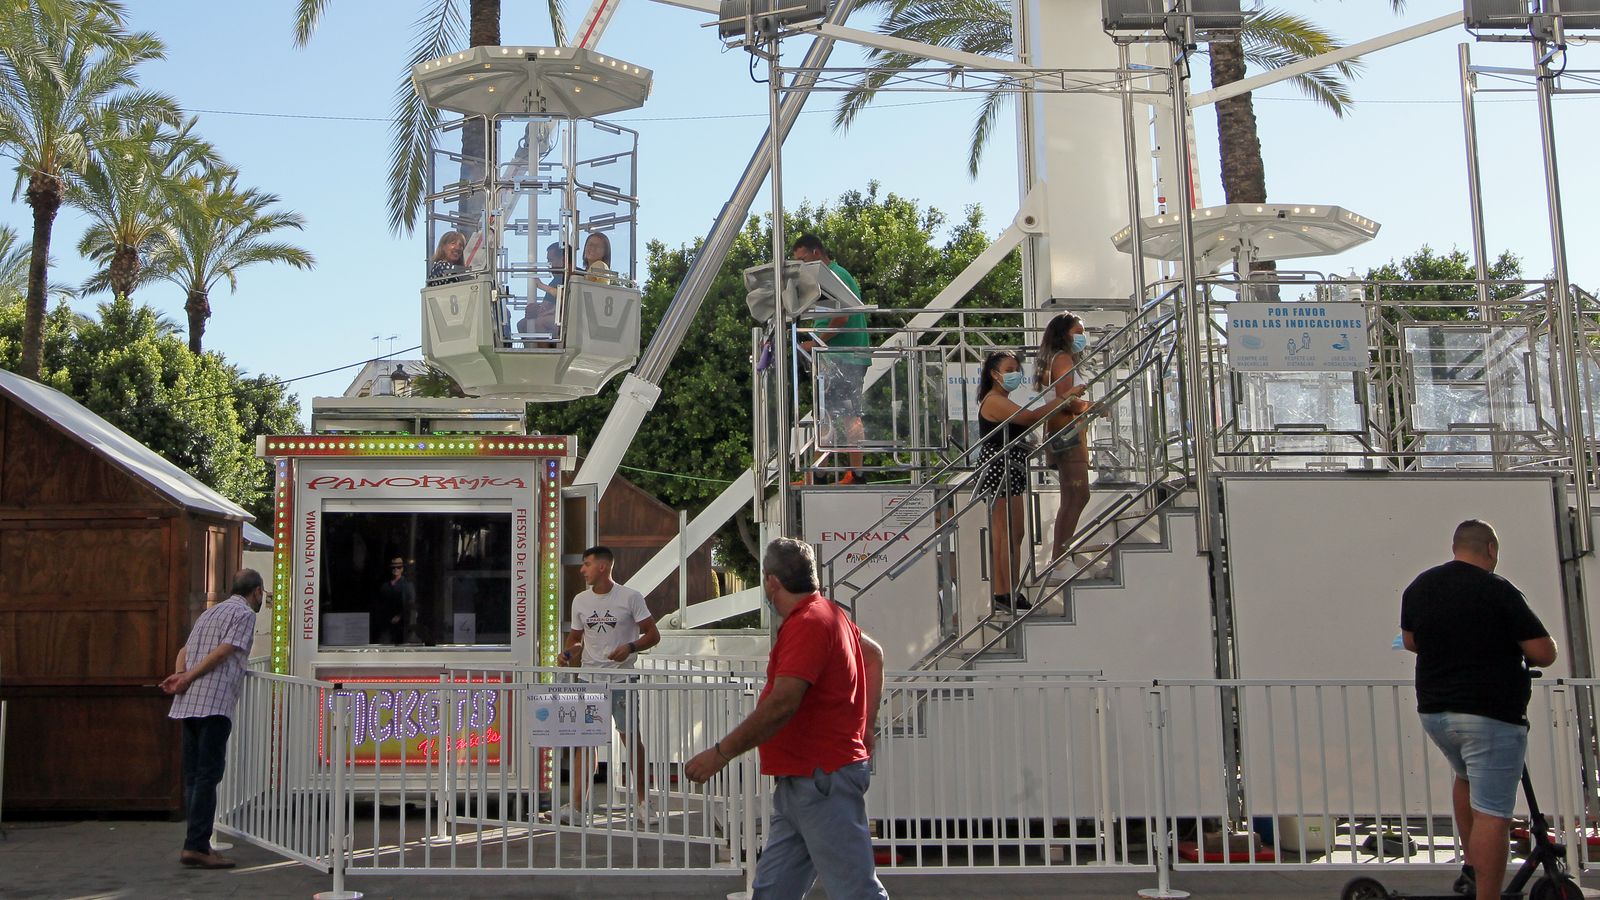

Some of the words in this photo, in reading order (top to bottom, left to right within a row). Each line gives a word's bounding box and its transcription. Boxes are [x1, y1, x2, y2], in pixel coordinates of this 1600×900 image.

[450, 295, 459, 316] 8
[604, 296, 613, 317] 8
[1268, 308, 1289, 317] POR
[1293, 308, 1326, 317] FAVOR
[1233, 319, 1258, 328] SIGA
[1262, 319, 1281, 328] LAS
[1286, 319, 1361, 328] INDICACIONES
[305, 510, 316, 563] VENDIMIA
[517, 508, 526, 549] FIESTAS
[821, 532, 910, 541] ENTRADA
[304, 598, 314, 640] FIESTAS
[517, 584, 526, 637] VENDIMIA
